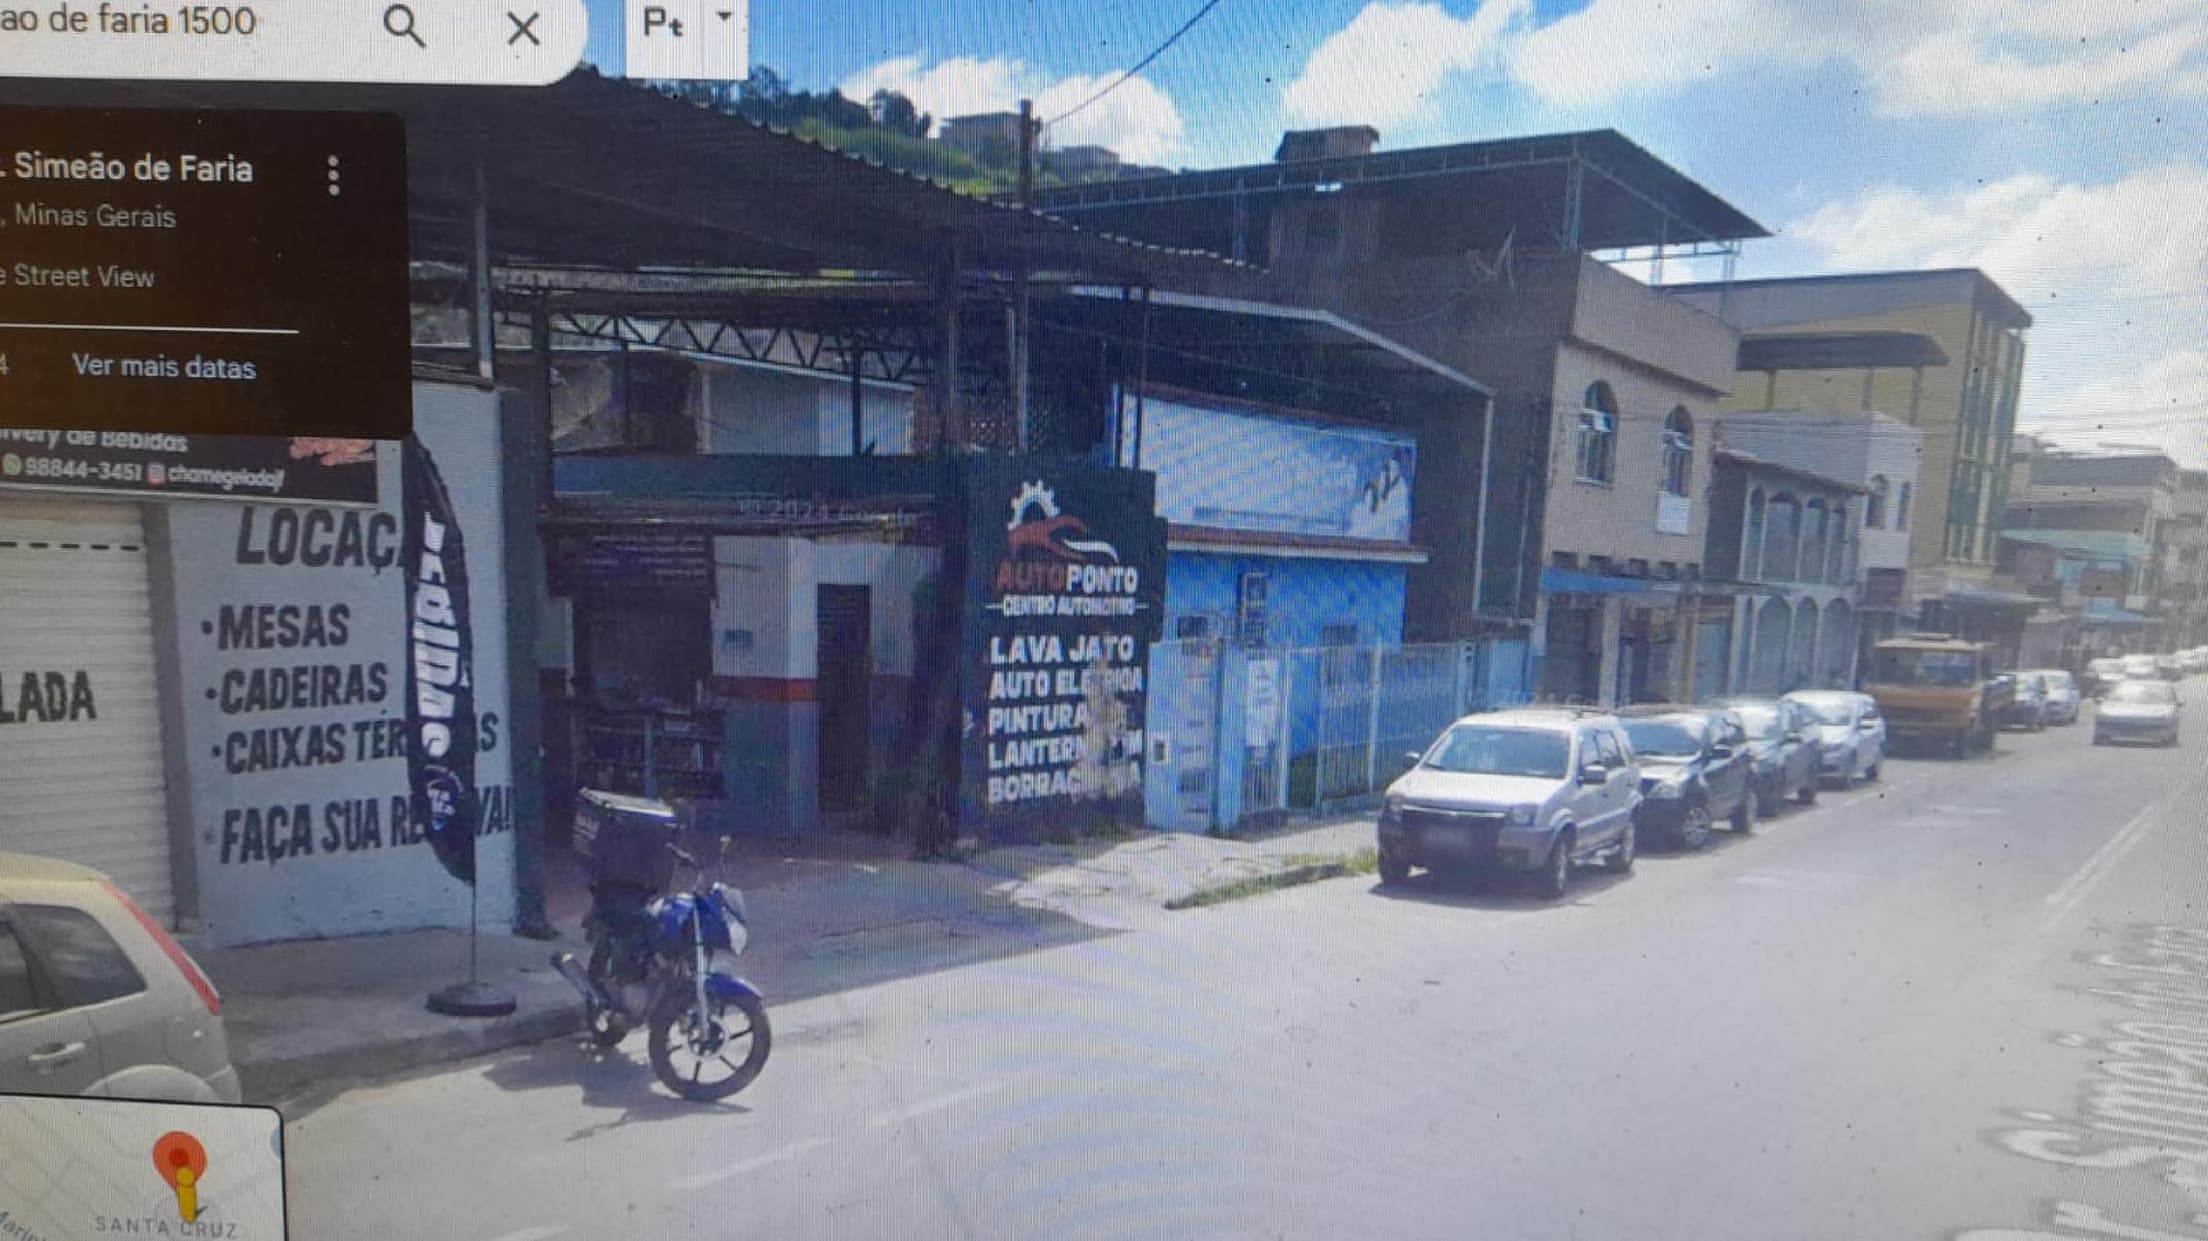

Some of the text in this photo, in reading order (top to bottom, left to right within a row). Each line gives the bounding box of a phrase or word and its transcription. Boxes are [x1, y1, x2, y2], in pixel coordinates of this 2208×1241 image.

[49, 2, 88, 32] de
[98, 3, 169, 33] faria
[178, 6, 256, 34] 1500
[15, 151, 254, 183] Simeão de Faria
[15, 203, 177, 228] Minas Gerais
[14, 264, 90, 287] Street
[97, 266, 155, 288] View
[72, 353, 257, 380] Ver mais datas
[101, 431, 189, 452] Bebidas
[25, 457, 143, 481] 98844-3451
[1003, 594, 1055, 616] CENTRO
[218, 603, 349, 650] MESAS
[990, 633, 1135, 665] LAVA JATO
[219, 661, 388, 715] CADEIRAS
[989, 669, 1050, 700] AUTO
[225, 723, 346, 774] CAIXAS
[220, 802, 313, 868] FAÇA
[321, 798, 382, 852] SUA
[96, 1215, 238, 1239] SANTA CRUZ
